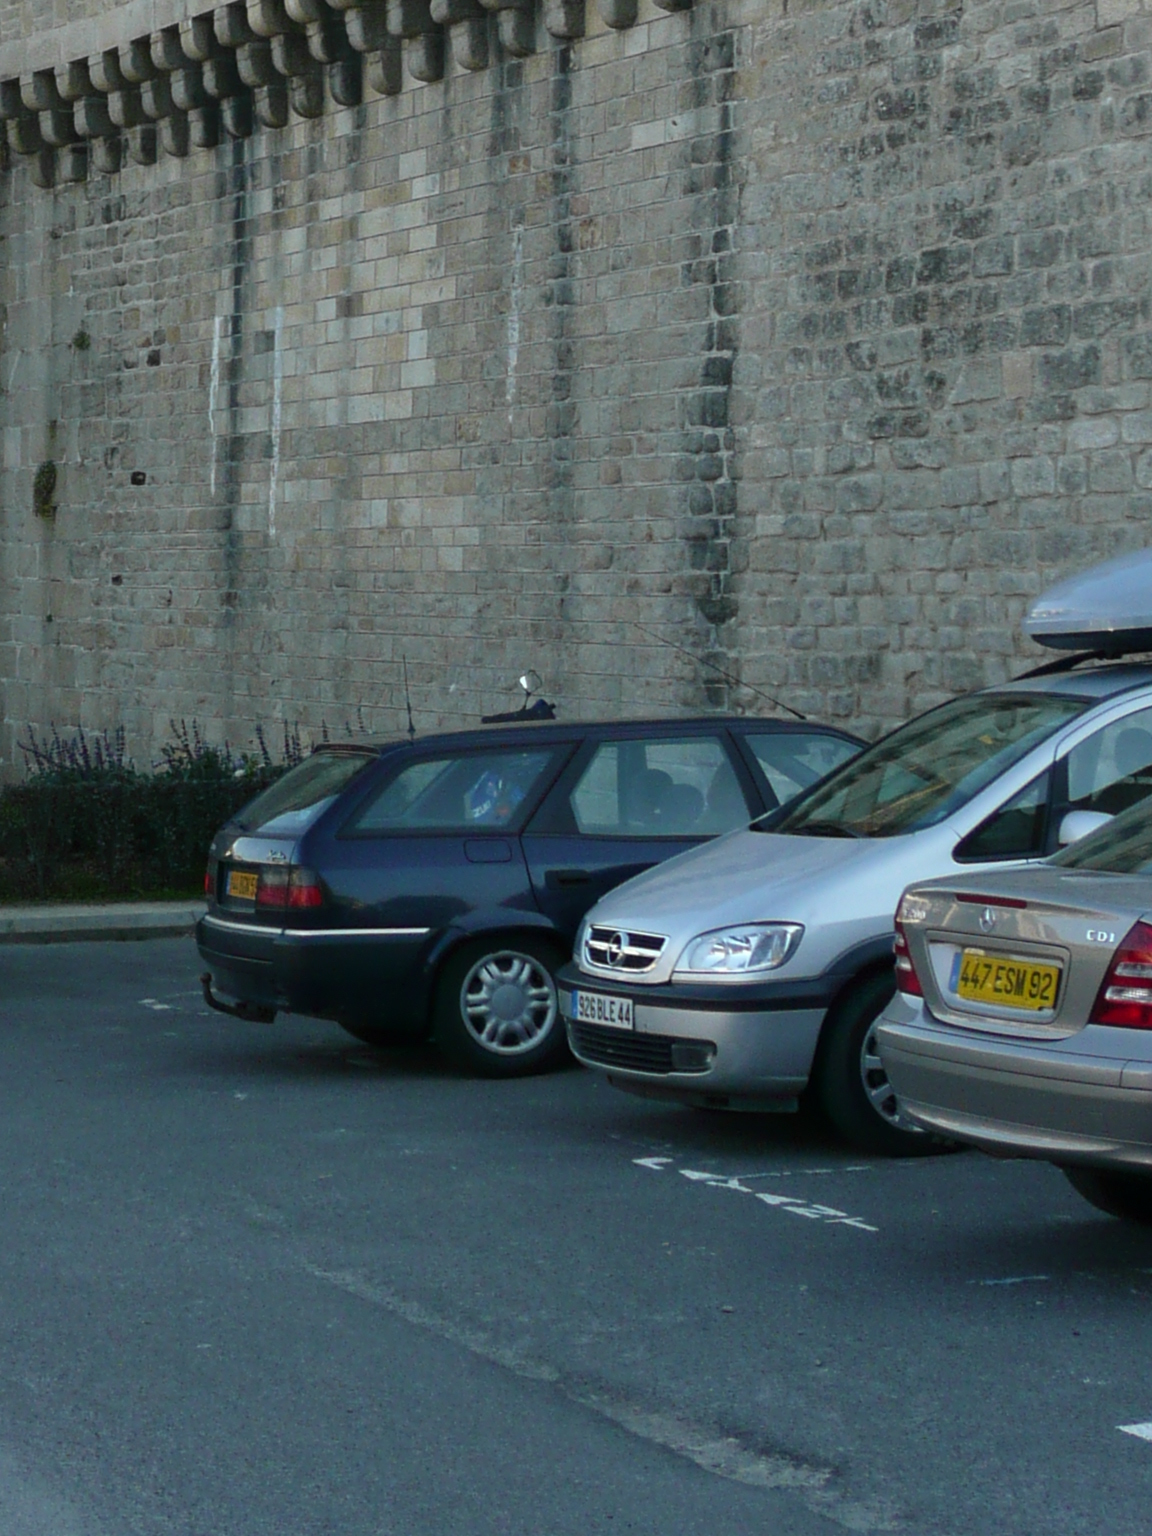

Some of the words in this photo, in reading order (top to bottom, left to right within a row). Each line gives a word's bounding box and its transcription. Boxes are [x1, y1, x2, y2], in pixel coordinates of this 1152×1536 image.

[1086, 929, 1116, 943] CDI
[960, 961, 992, 991] 447
[993, 965, 1026, 996] ESM
[1028, 971, 1054, 1002] 92
[617, 1002, 631, 1025] 44
